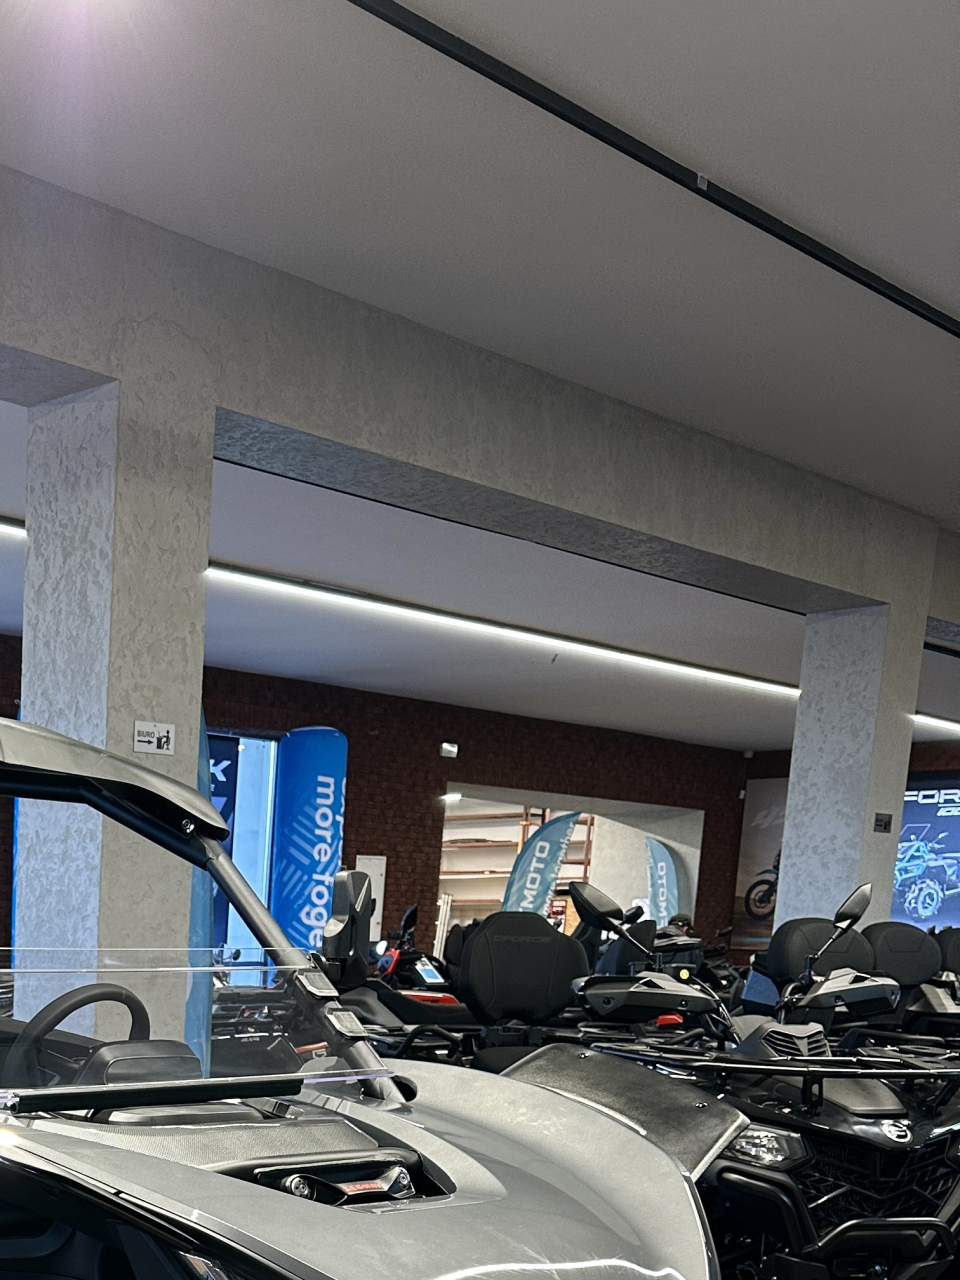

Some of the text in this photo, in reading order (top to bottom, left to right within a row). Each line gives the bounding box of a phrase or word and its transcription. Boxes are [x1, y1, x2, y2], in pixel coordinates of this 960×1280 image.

[137, 730, 156, 739] BIURO
[209, 759, 232, 782] K
[903, 789, 960, 803] FOR
[300, 774, 335, 948] more toge
[518, 841, 550, 912] MOTO
[543, 883, 556, 915] more
